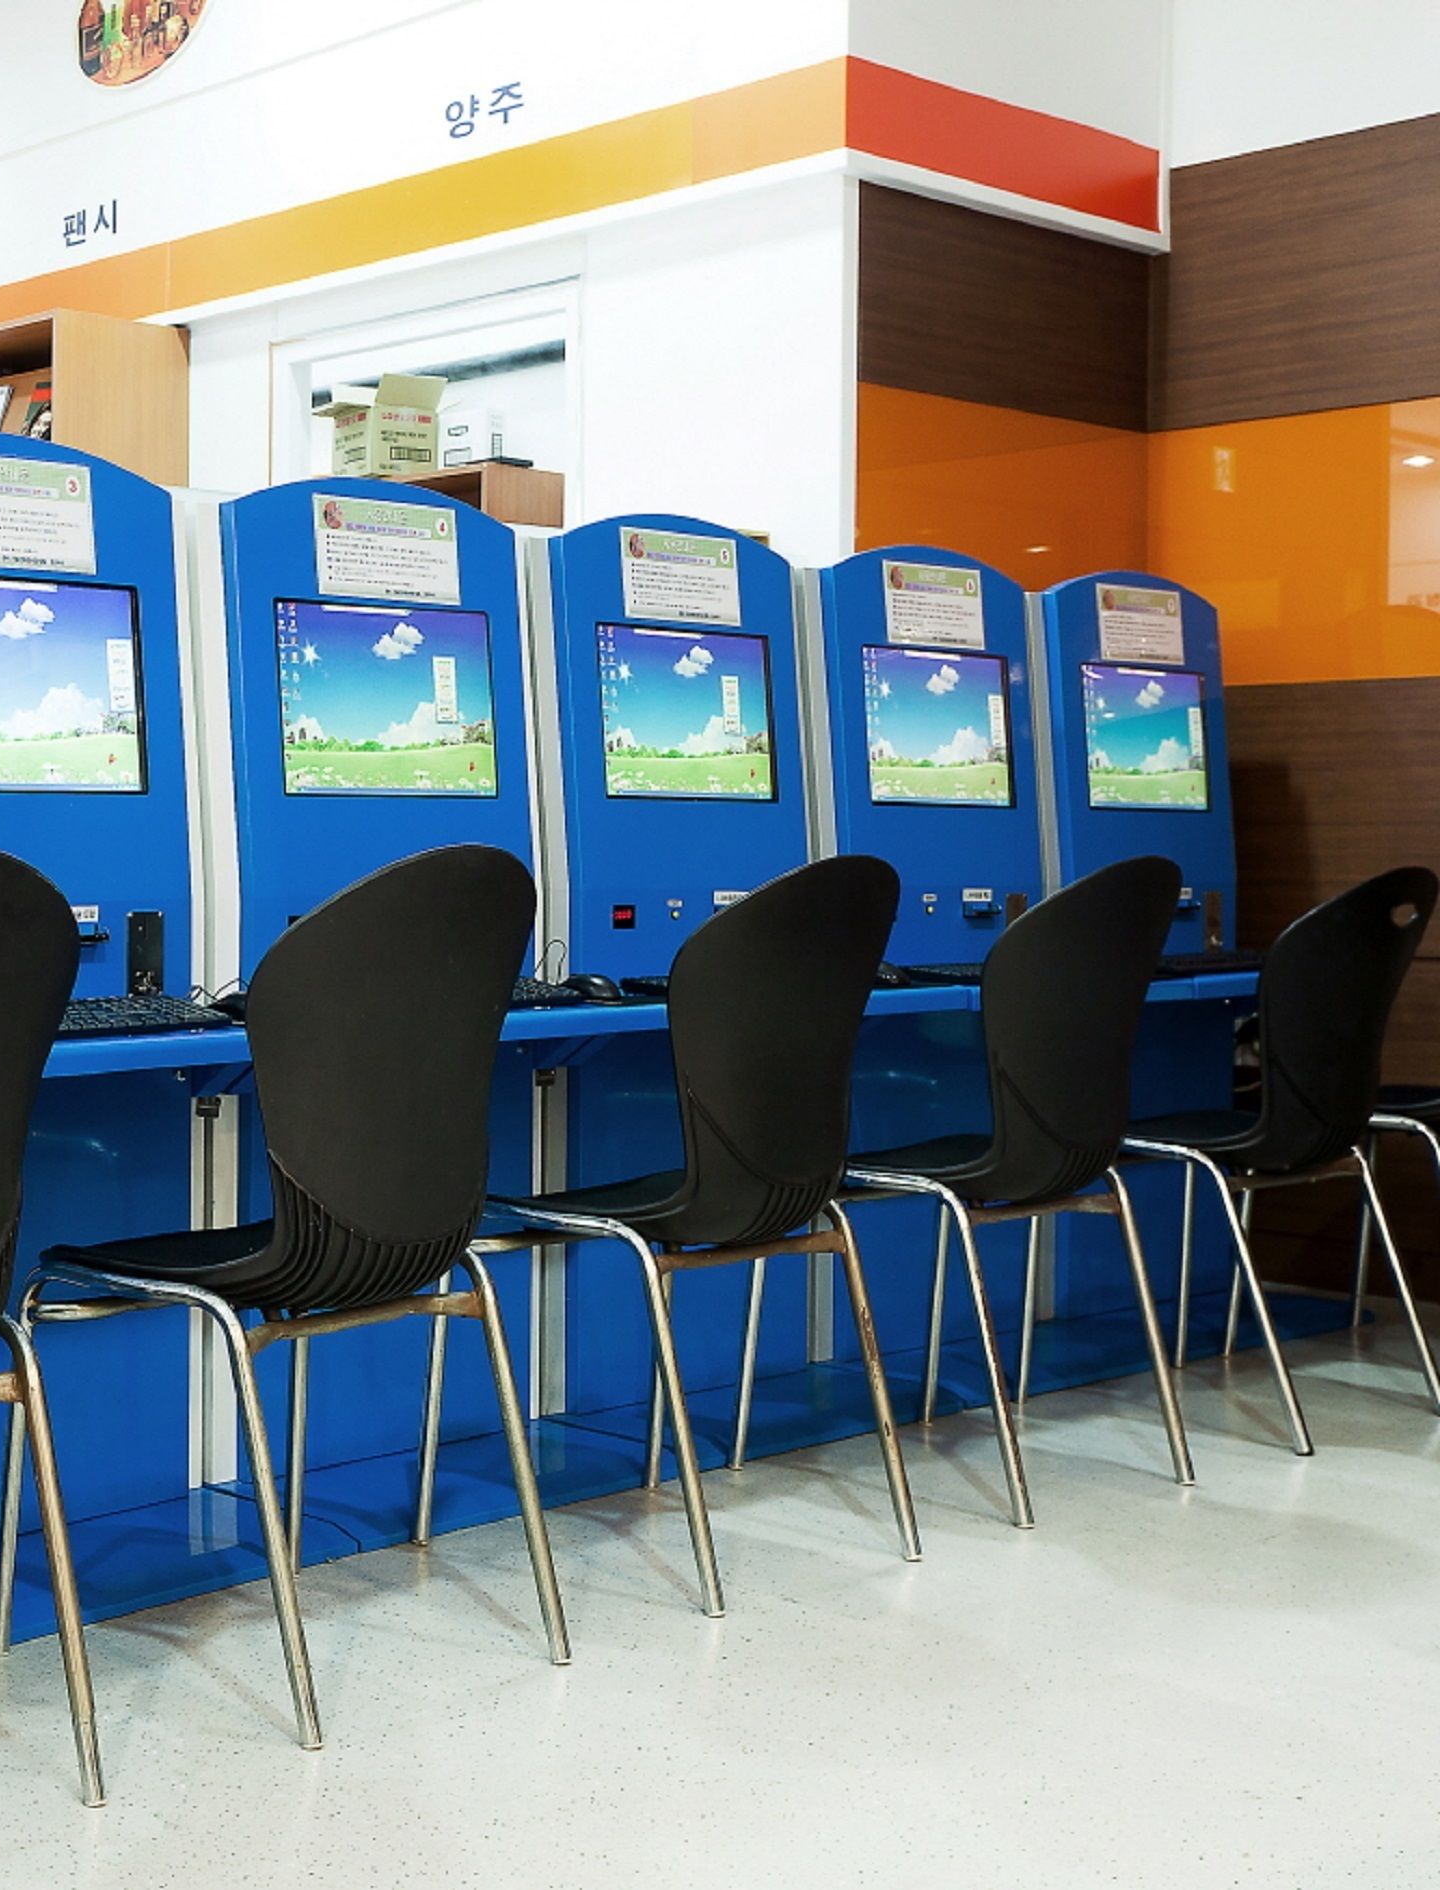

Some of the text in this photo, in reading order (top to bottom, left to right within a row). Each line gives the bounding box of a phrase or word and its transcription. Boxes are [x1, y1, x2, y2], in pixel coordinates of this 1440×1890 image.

[444, 81, 525, 140] 양주
[62, 199, 119, 248] 팬시
[68, 479, 79, 494] 3
